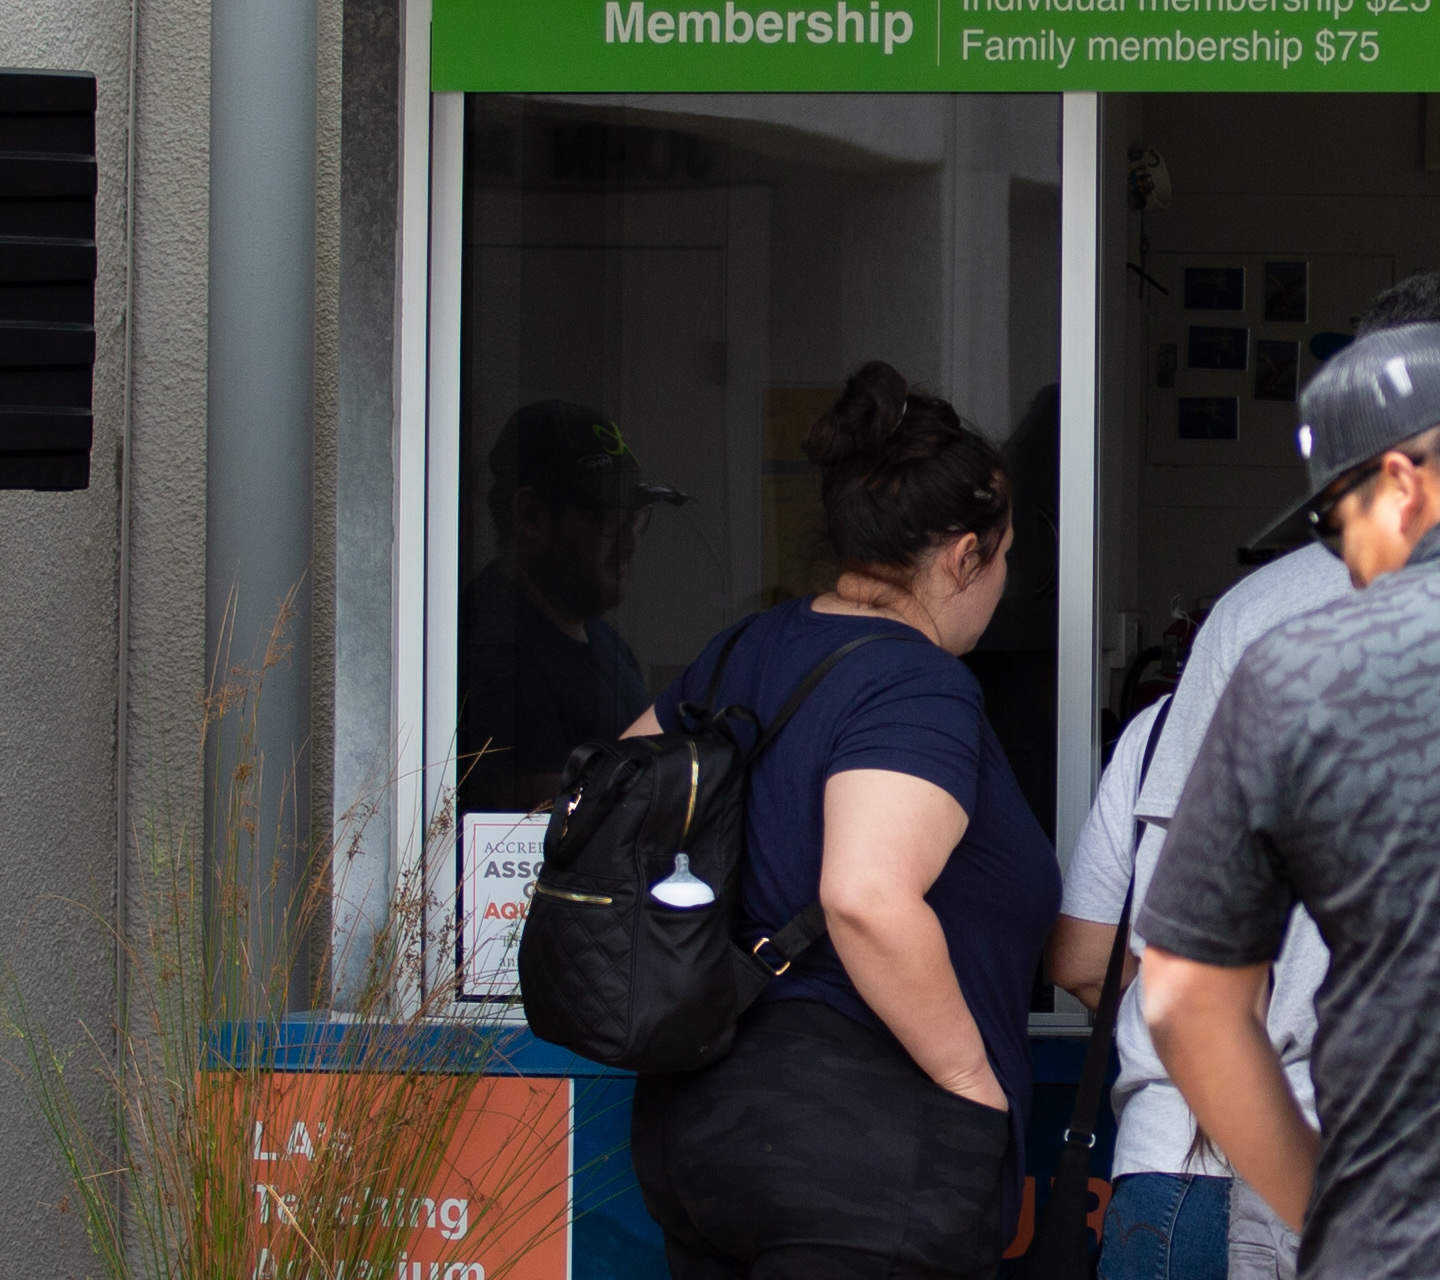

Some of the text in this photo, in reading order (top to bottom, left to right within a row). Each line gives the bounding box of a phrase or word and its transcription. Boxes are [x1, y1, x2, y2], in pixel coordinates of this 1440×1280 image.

[606, 1, 913, 54] Membership
[963, 28, 1379, 69] Family membership $75
